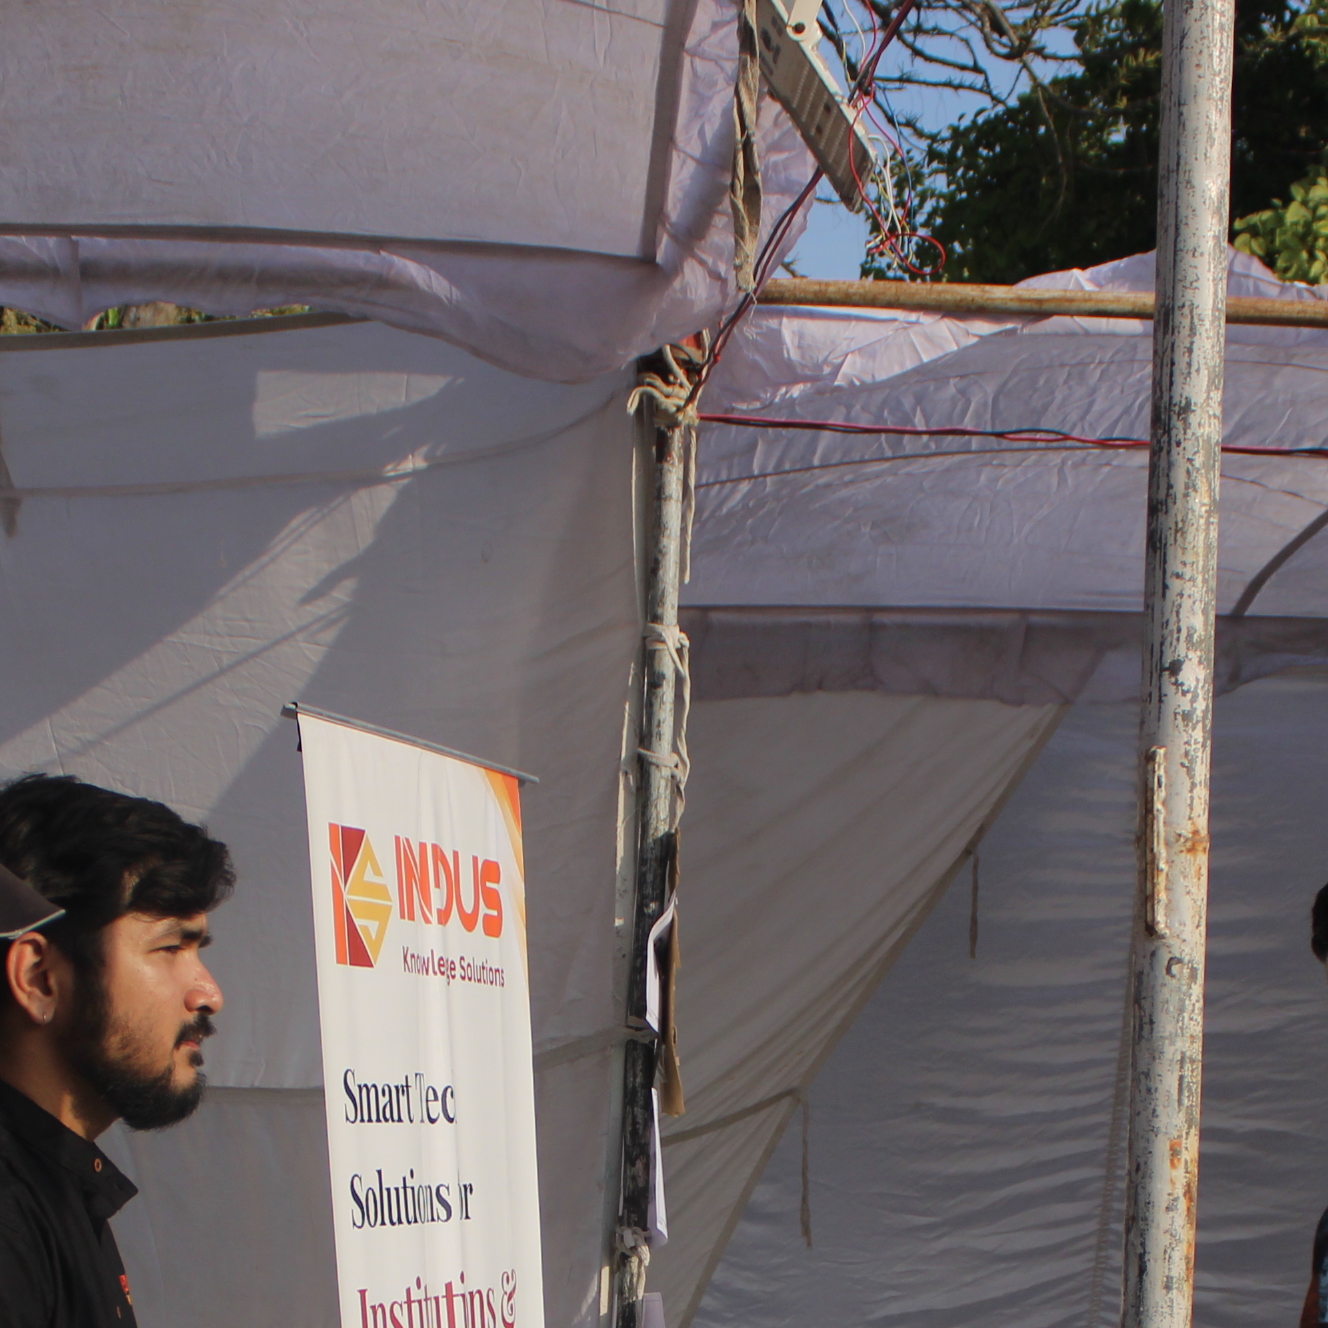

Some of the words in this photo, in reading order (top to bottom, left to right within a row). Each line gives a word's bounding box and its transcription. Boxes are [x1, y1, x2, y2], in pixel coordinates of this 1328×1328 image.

[394, 834, 503, 938] INDUS
[459, 955, 504, 988] Solutions
[343, 1068, 414, 1124] Smart
[349, 1168, 452, 1230] Solutions
